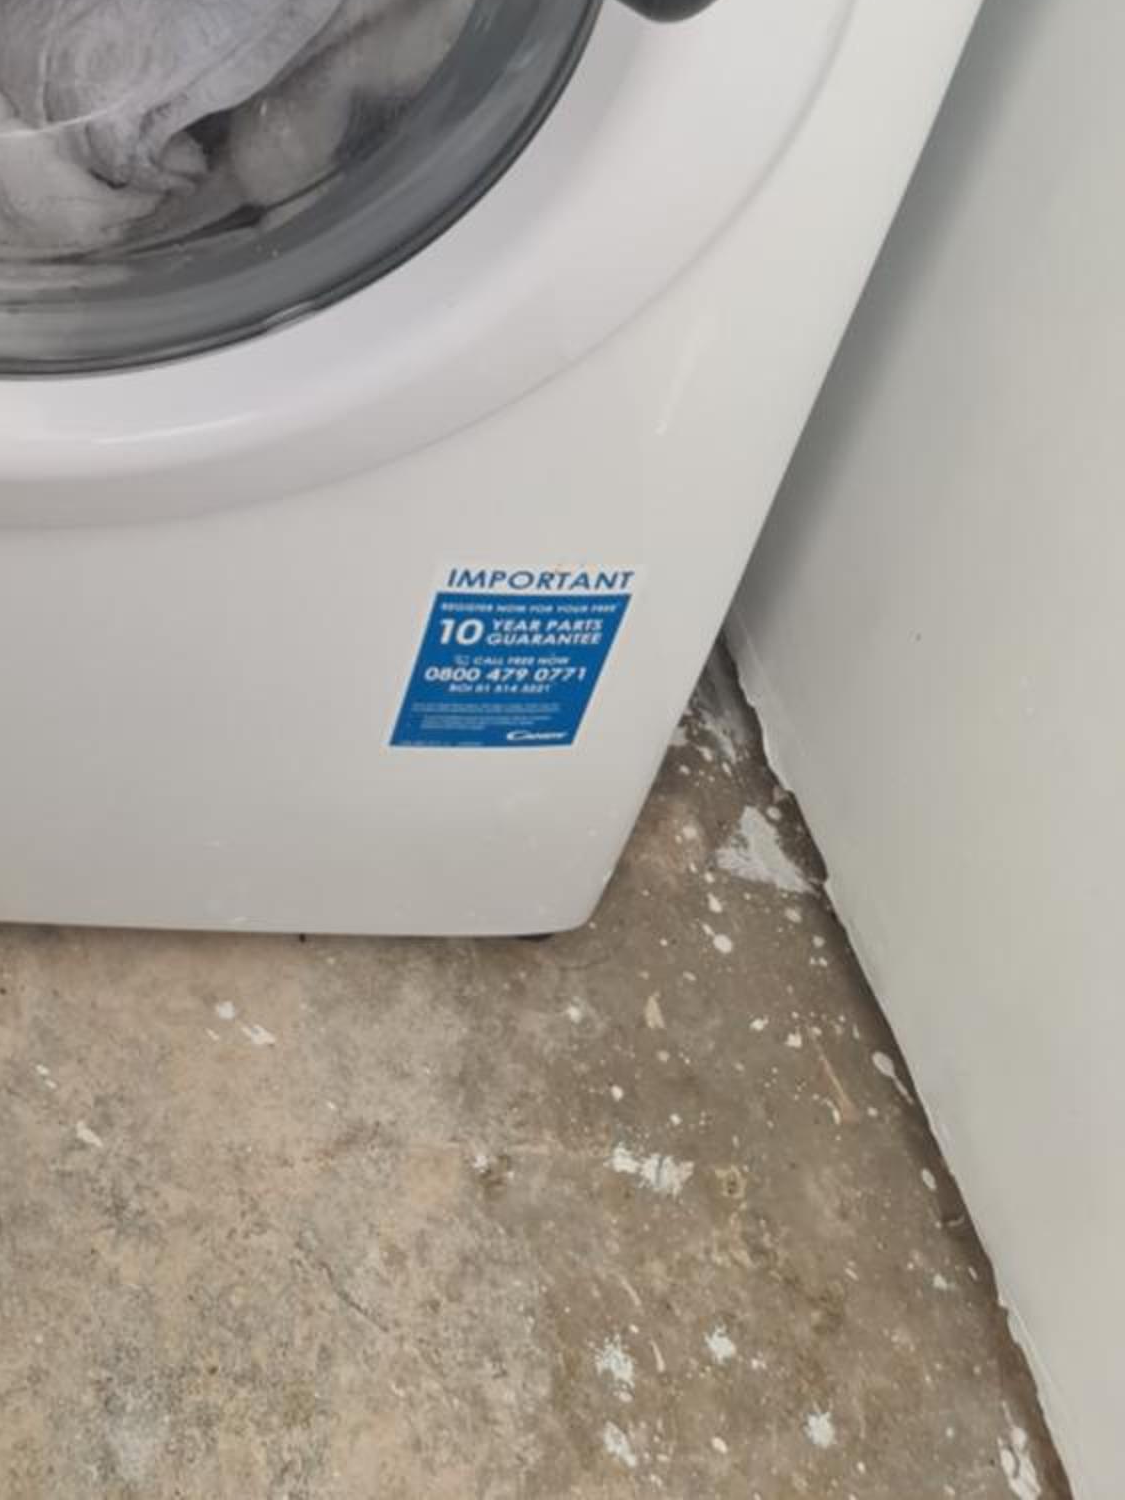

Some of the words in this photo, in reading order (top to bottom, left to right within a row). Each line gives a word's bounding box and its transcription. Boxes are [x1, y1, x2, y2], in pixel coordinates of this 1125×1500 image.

[447, 567, 636, 591] IMPORTANT
[438, 617, 485, 646] 10
[491, 618, 543, 632] YEAR
[545, 619, 604, 632] PARTS
[485, 632, 603, 646] GUARANTEE
[472, 656, 504, 666] CALL
[424, 666, 481, 682] 0800
[485, 667, 529, 681] 479
[533, 667, 587, 682] 0771
